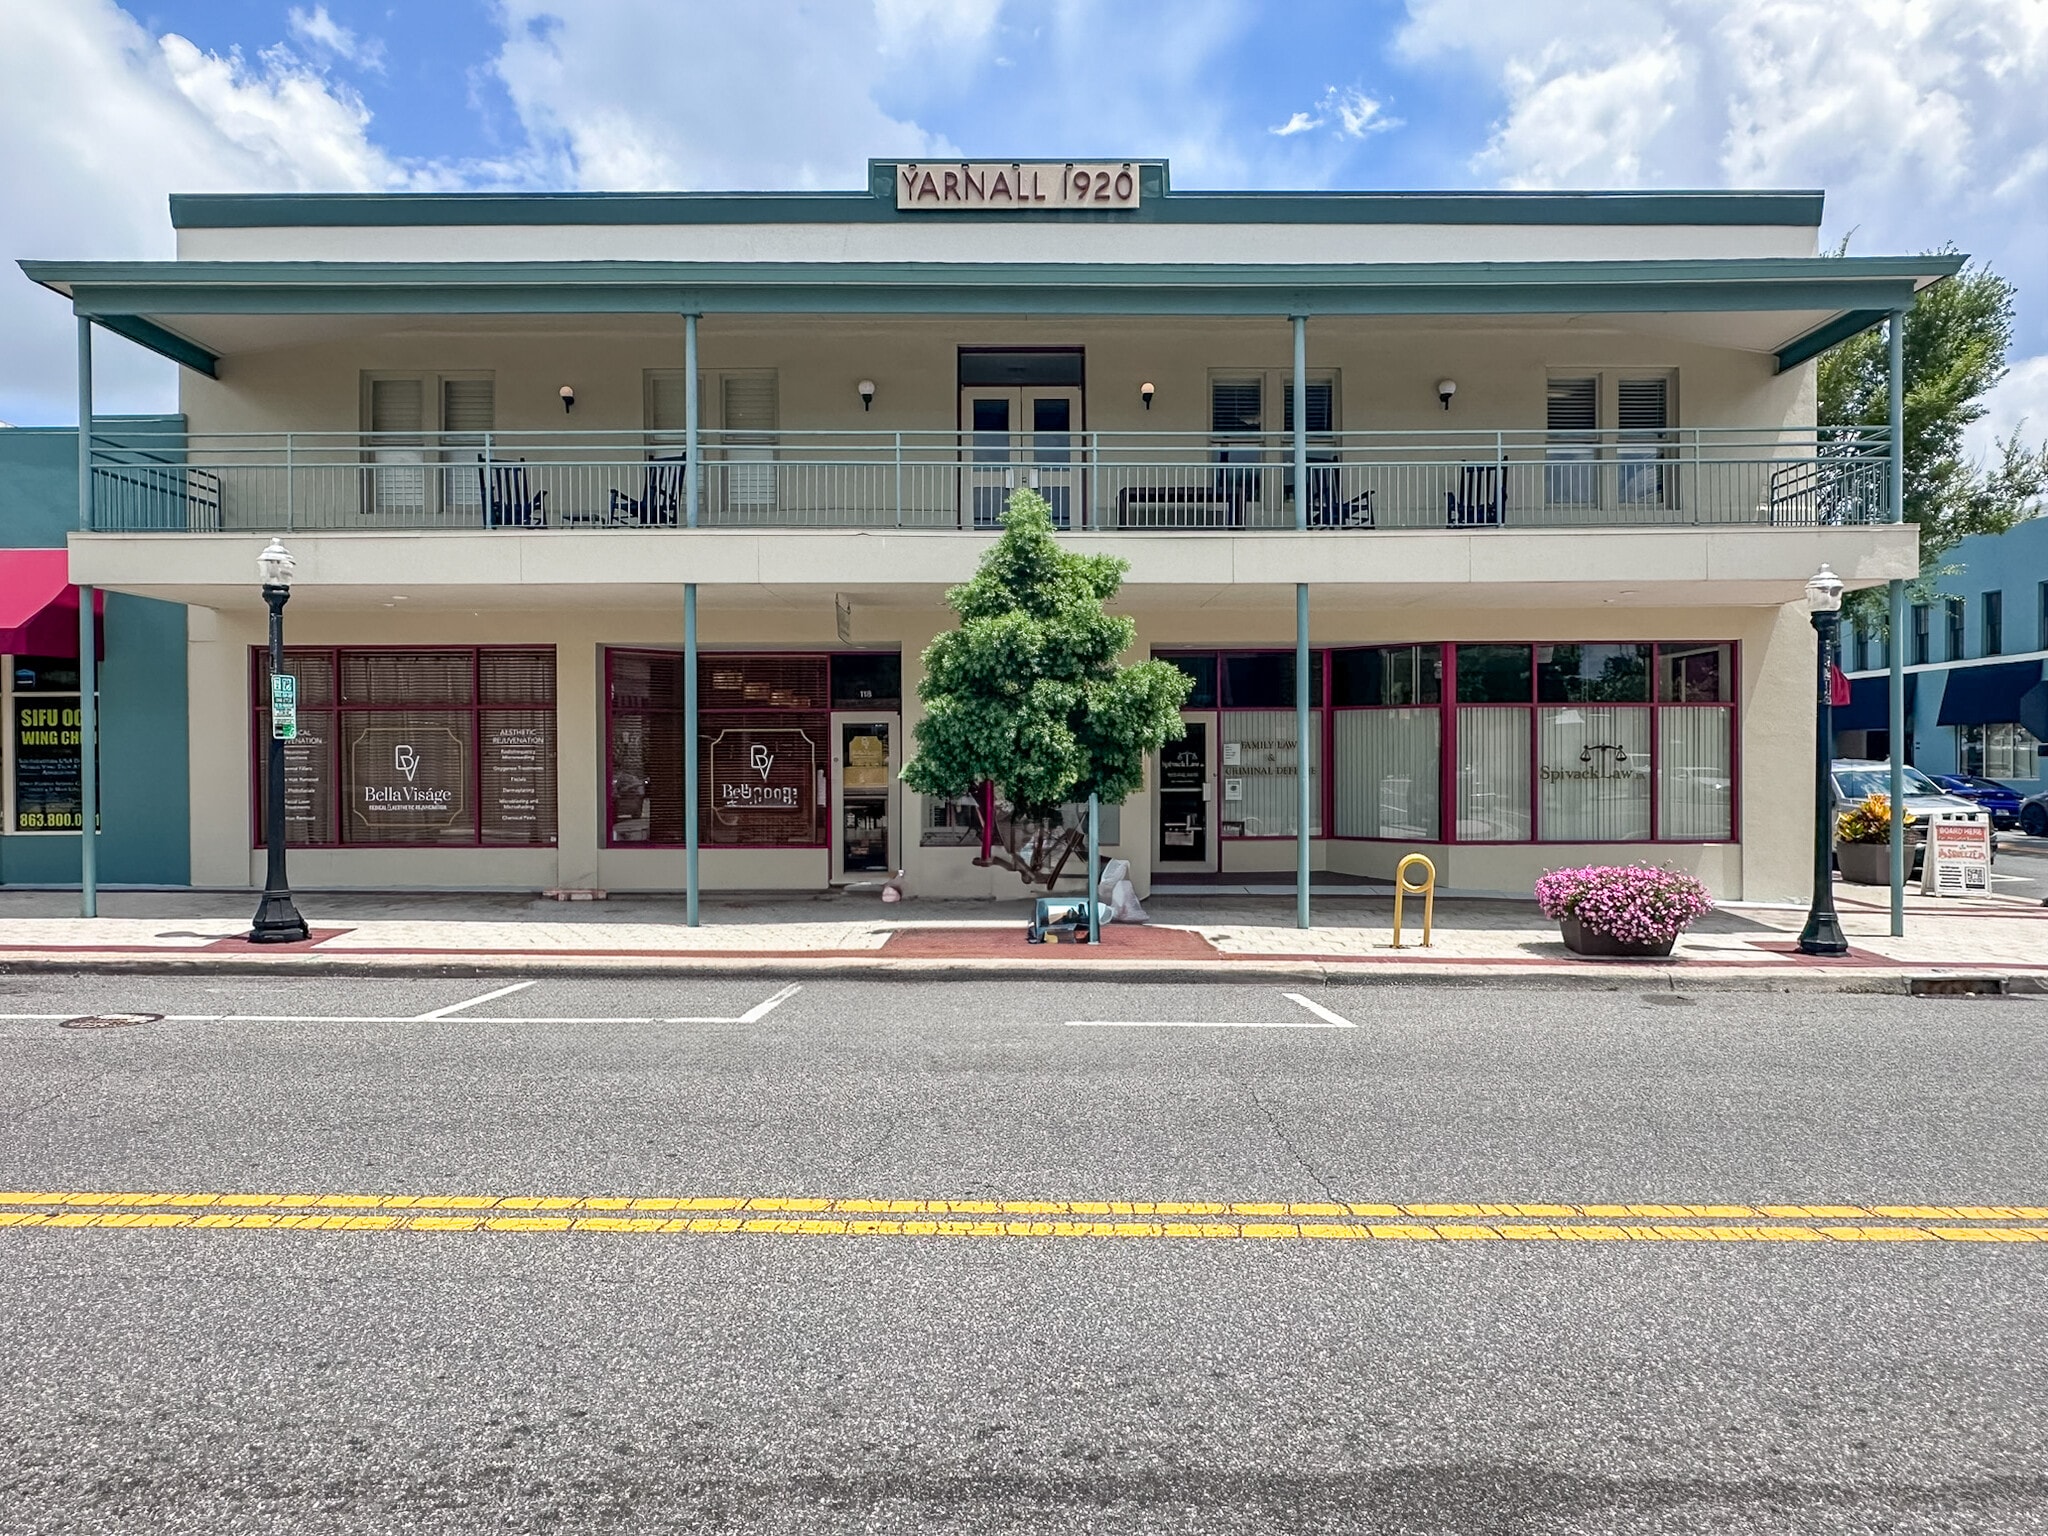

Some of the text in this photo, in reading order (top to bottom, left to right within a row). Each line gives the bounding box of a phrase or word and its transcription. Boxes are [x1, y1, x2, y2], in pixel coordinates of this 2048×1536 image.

[902, 171, 1133, 201] YARNALL 1920
[21, 708, 96, 727] SIFU OC
[21, 731, 97, 745] WING CH
[1241, 740, 1297, 750] FAMILY LAW
[1268, 754, 1276, 762] &
[1225, 766, 1273, 775] CRIMINAL
[1540, 766, 1599, 784] Spivack
[365, 787, 452, 804] Bella Viságe
[20, 813, 99, 827] 863.800.01
[1939, 827, 1963, 835] BOARD
